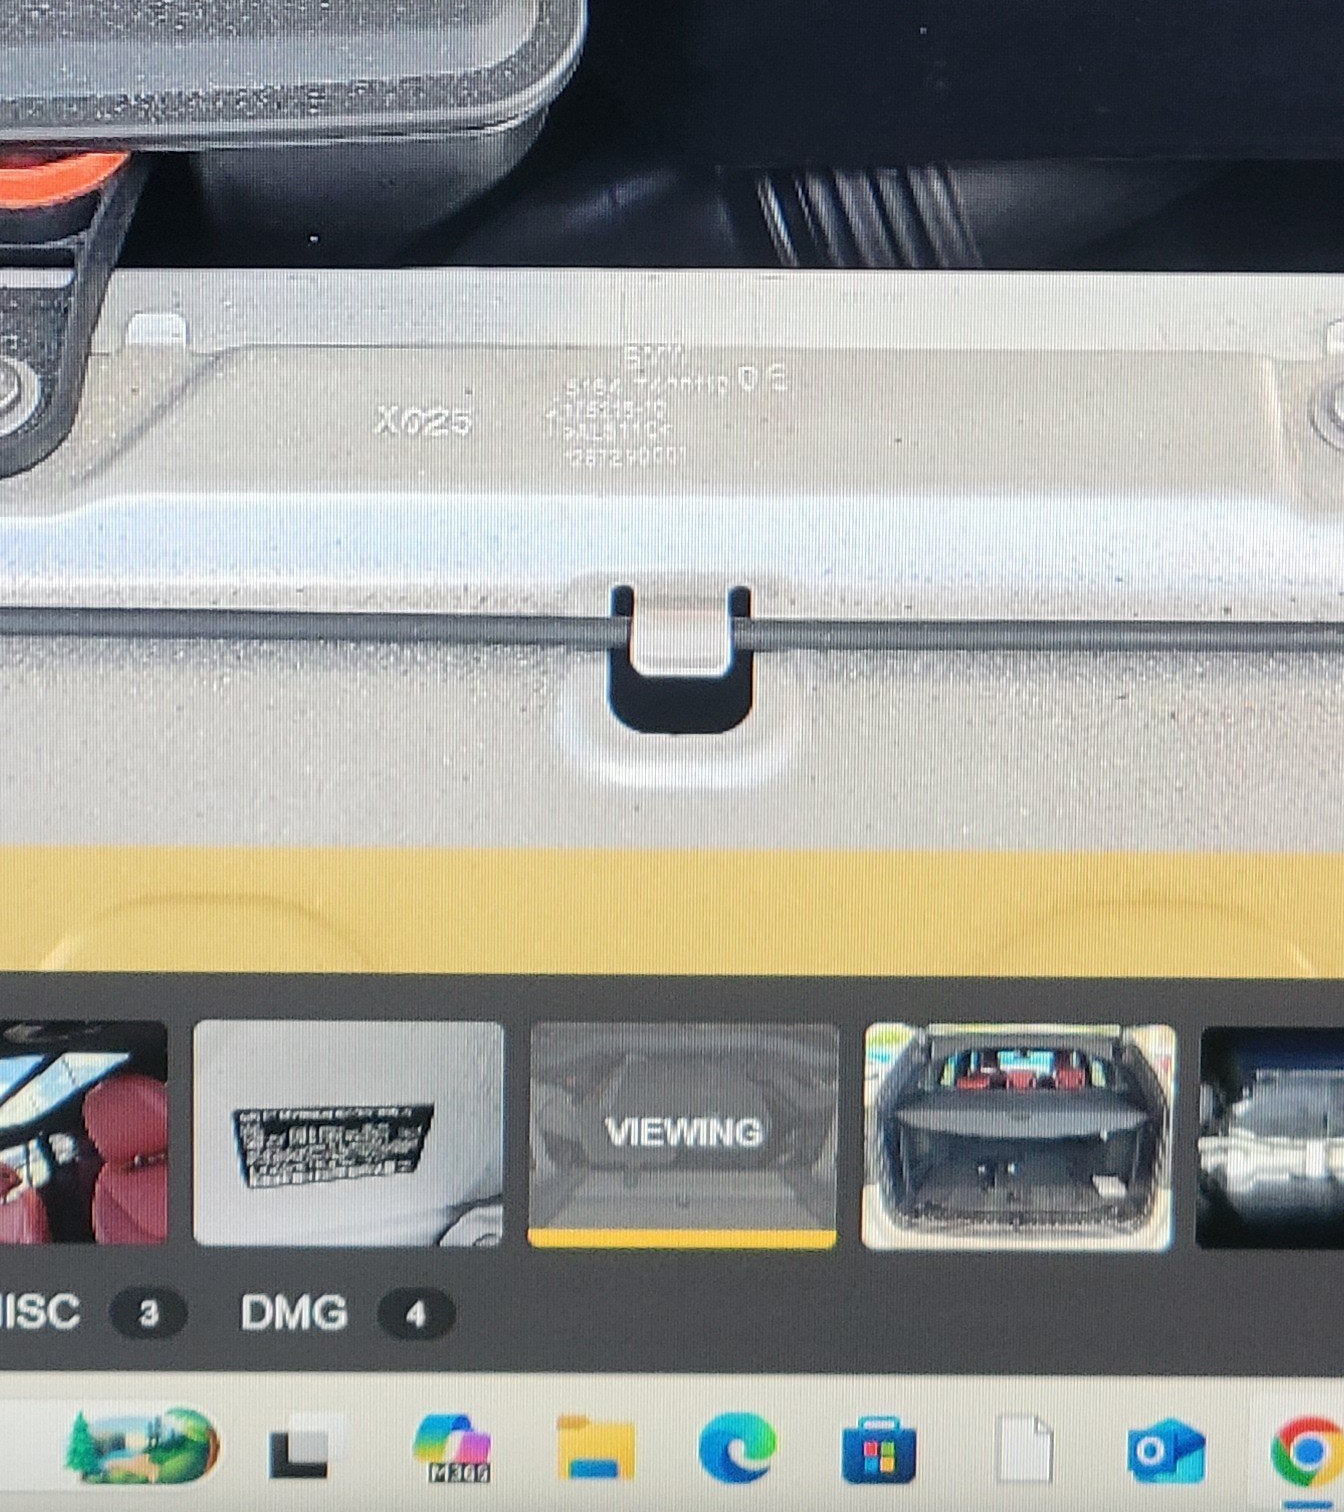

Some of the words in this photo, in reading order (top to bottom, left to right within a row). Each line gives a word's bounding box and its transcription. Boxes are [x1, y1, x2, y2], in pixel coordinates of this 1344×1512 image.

[604, 1116, 765, 1148] VIEWING
[139, 1300, 159, 1327] 3
[241, 1294, 348, 1331] DMG
[405, 1300, 427, 1327] 4
